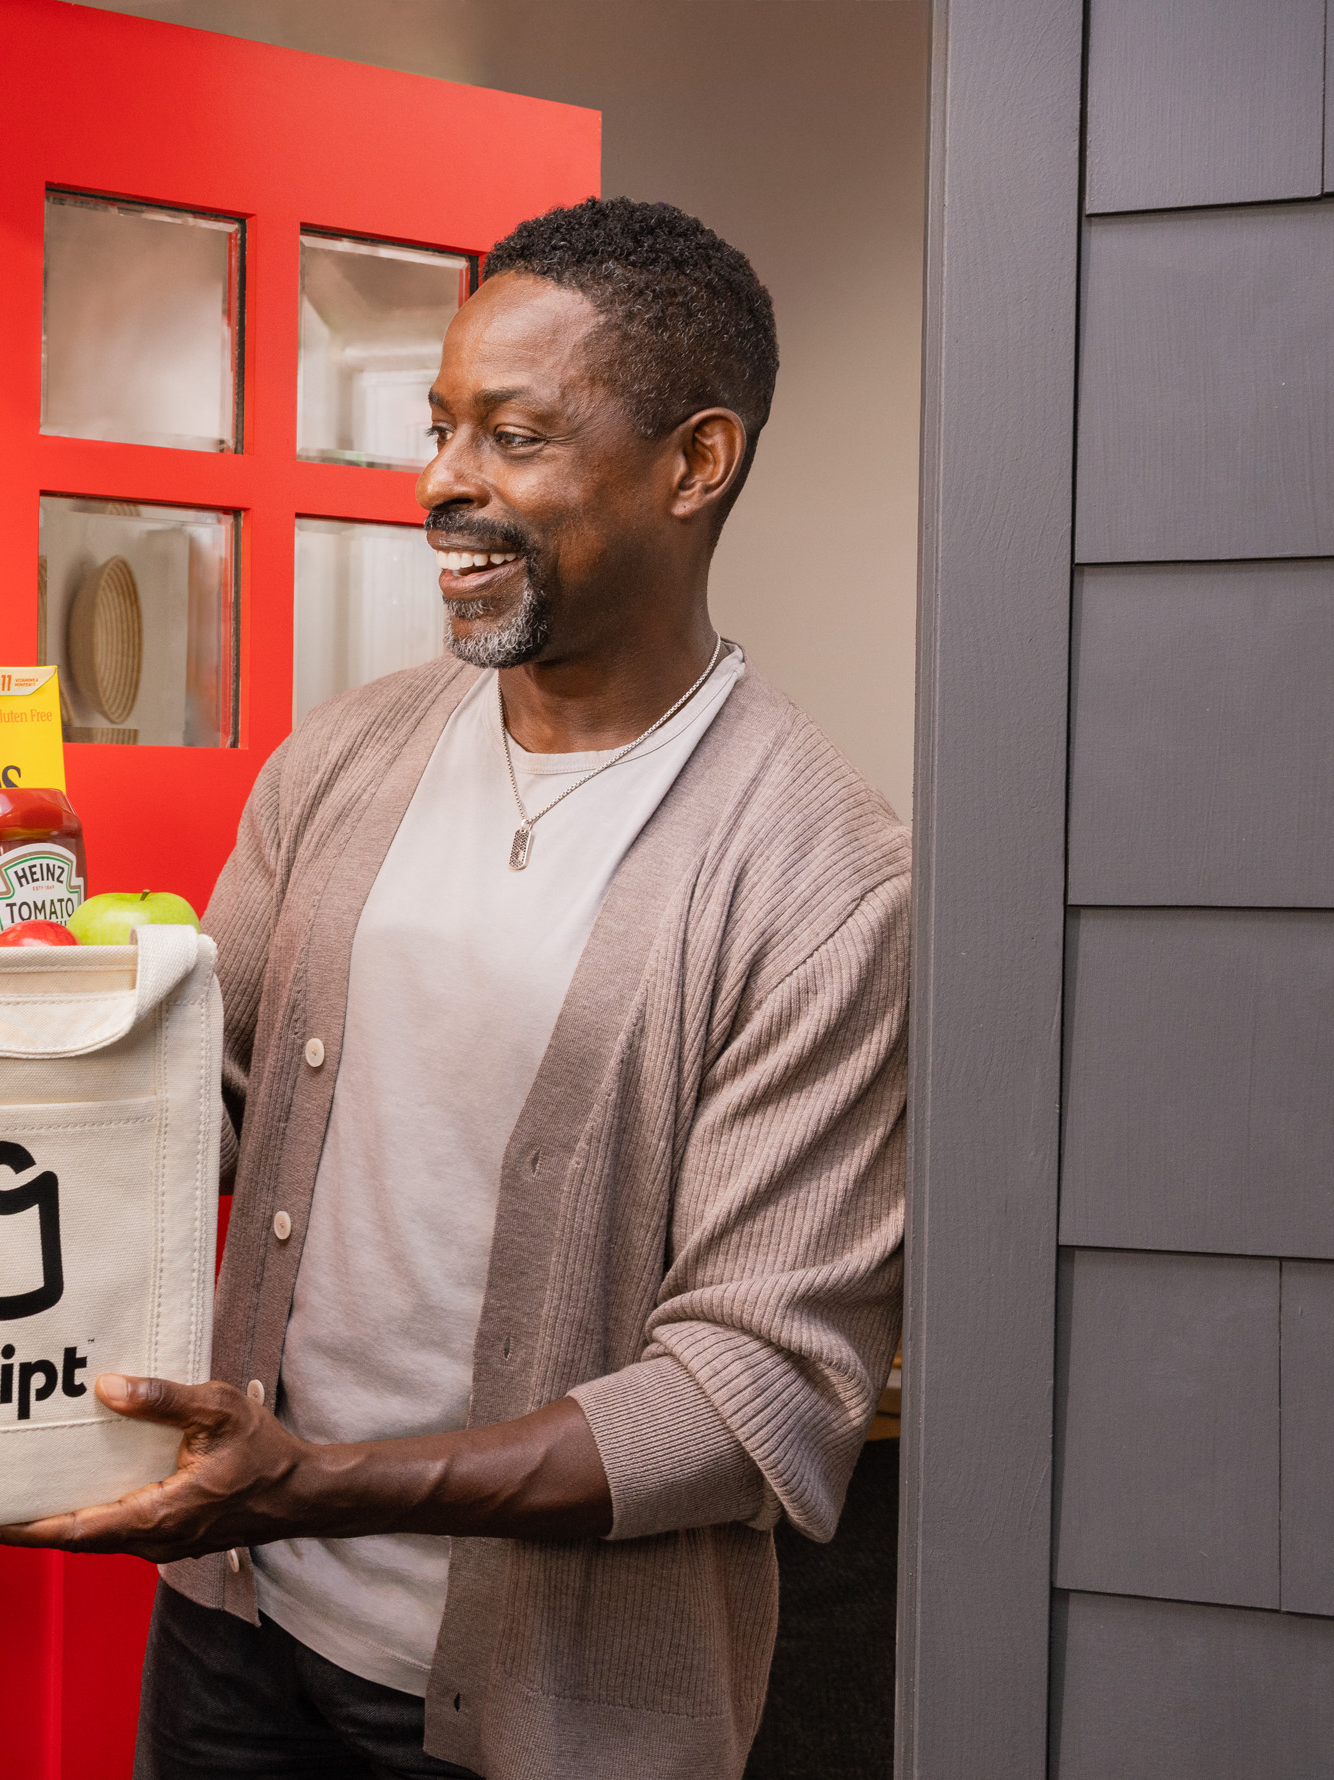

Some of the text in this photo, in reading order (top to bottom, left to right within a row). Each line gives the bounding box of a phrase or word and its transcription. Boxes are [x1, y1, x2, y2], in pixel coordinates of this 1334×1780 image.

[1, 674, 12, 692] 11
[30, 708, 53, 722] Free
[14, 863, 65, 888] HEINZ
[5, 897, 75, 924] TOMATO
